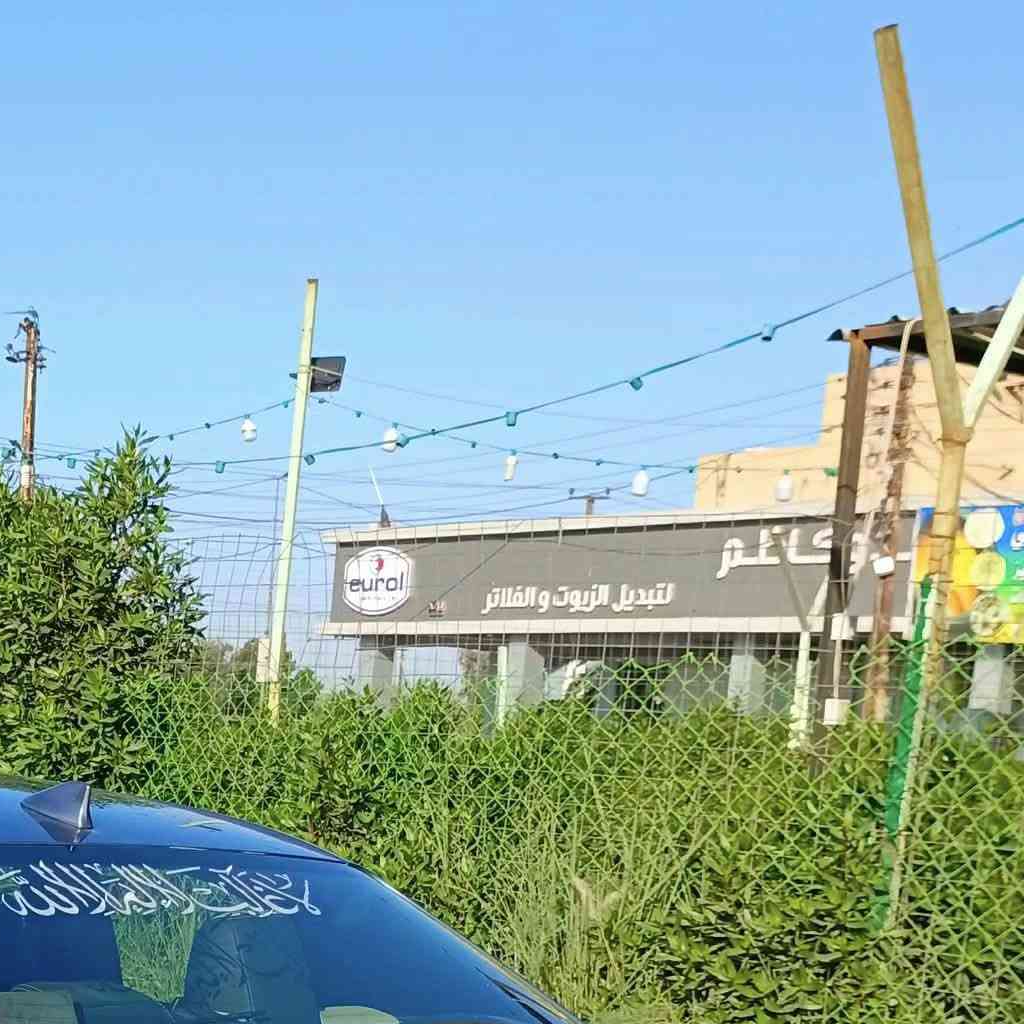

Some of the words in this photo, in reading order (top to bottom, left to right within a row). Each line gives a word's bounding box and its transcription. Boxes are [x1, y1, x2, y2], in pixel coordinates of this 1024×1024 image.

[349, 571, 404, 593] eurol
[553, 584, 610, 612] الزيوت
[611, 583, 675, 611] لتبديل
